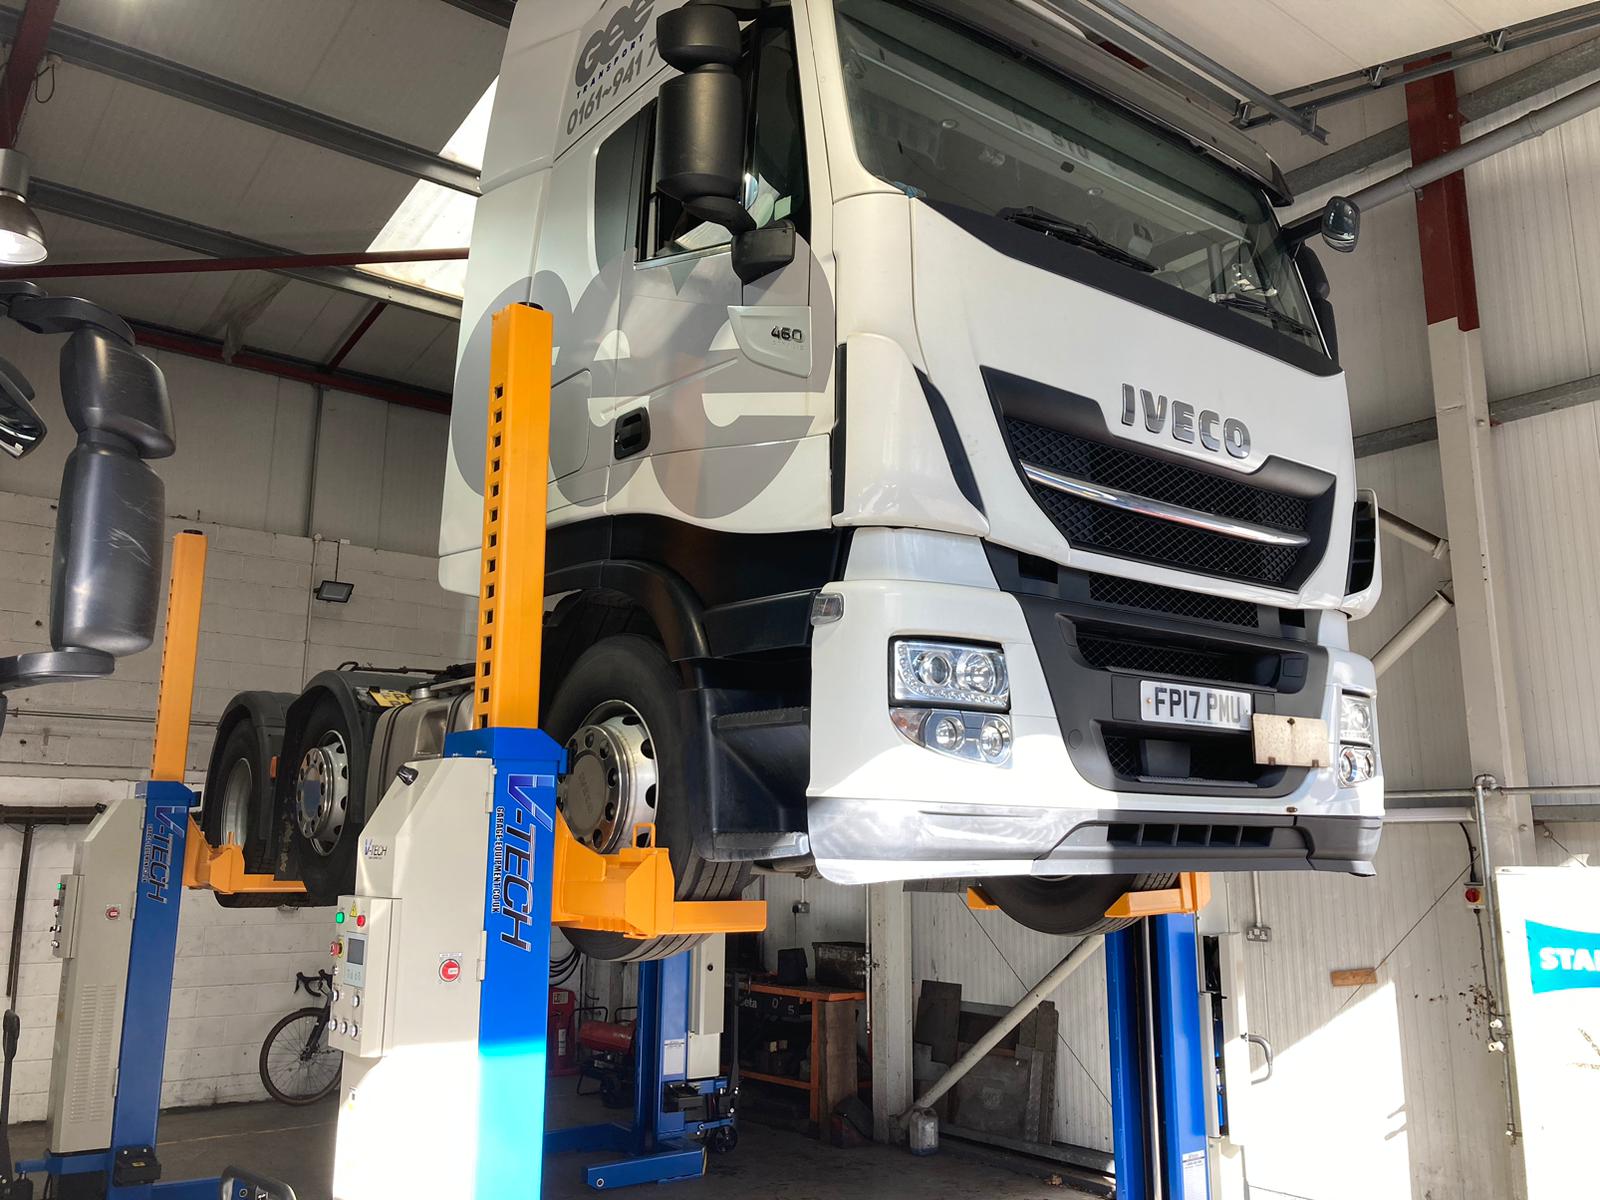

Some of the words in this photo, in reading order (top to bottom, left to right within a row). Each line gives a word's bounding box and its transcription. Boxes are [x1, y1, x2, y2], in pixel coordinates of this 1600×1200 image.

[576, 33, 644, 99] TRANSPORT
[771, 326, 803, 343] 460
[1121, 383, 1251, 459] IVECO
[1155, 687, 1201, 719] FP17
[1206, 692, 1242, 724] PMU
[146, 805, 188, 904] V-TECH
[500, 774, 555, 952] V-TECH
[1539, 947, 1600, 972] STA
